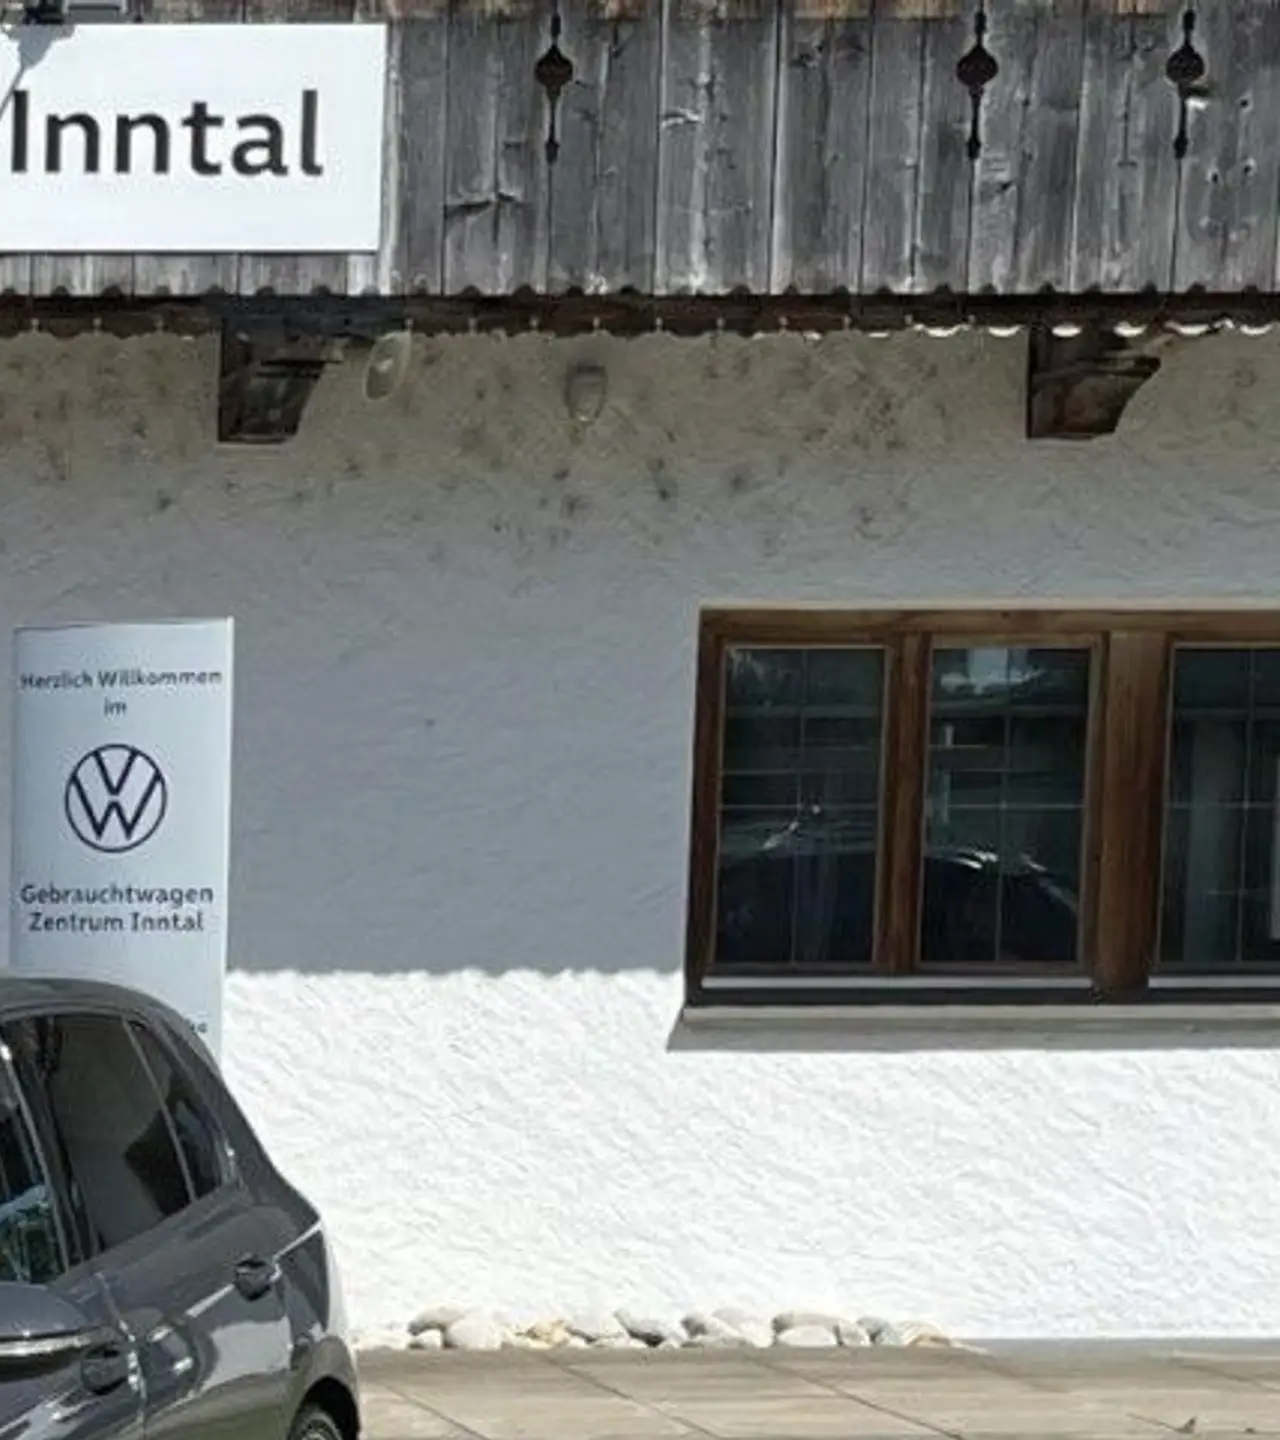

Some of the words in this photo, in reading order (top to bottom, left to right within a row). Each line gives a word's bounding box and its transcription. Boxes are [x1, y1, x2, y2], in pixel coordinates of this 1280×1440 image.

[10, 88, 324, 176] Inntal
[20, 669, 93, 689] Herzlich
[97, 669, 222, 689] Willkommen
[104, 697, 127, 716] im
[65, 744, 167, 853] VW
[20, 884, 214, 906] Gebrauchtwagen
[28, 912, 125, 932] Zentrum
[130, 911, 204, 932] Inntal
